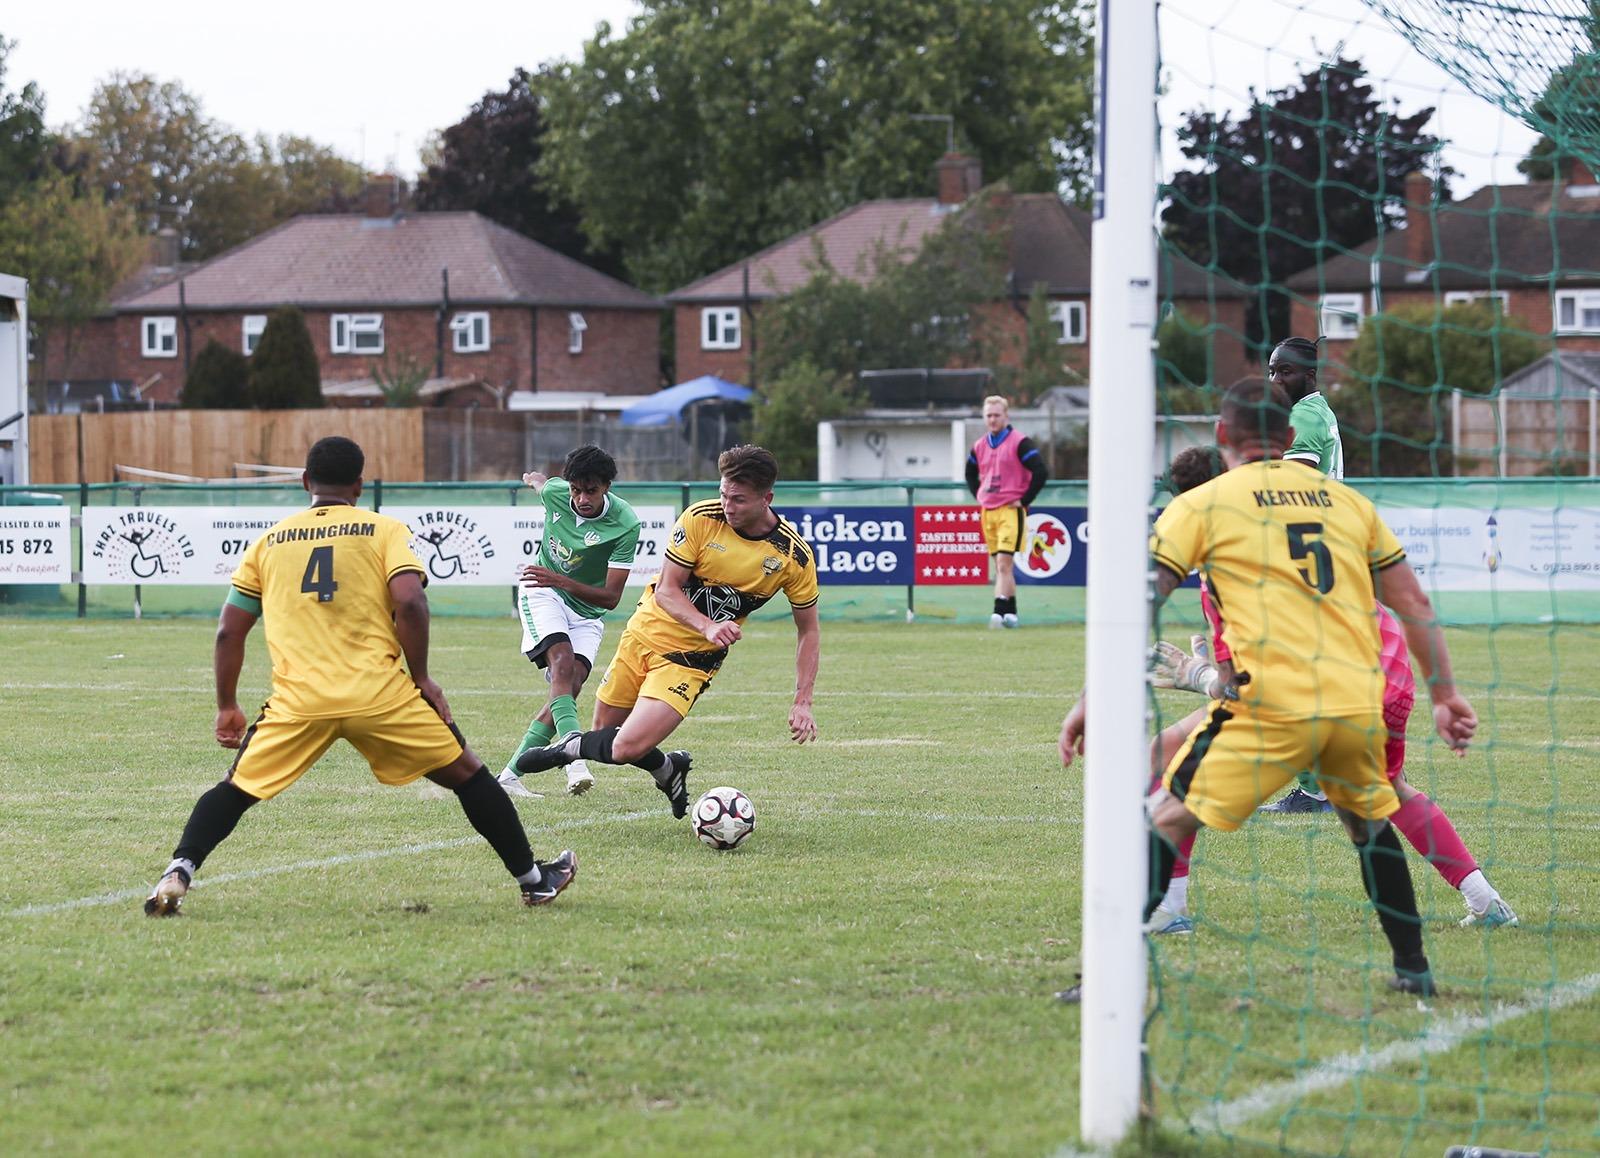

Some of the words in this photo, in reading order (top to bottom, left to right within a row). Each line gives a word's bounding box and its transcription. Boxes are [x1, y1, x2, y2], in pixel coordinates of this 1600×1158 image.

[1253, 489, 1333, 508] KEATING
[514, 521, 545, 529] INFO@
[640, 521, 666, 529] O.UK
[1409, 524, 1472, 537] business
[93, 525, 116, 558] SHAZ
[119, 511, 177, 533] TRAVELS
[177, 534, 195, 558] LTD
[266, 523, 376, 548] CUNNINGHAM
[418, 511, 478, 533] TRAVELS
[478, 534, 495, 559] LTD
[920, 532, 956, 543] TASTE
[956, 532, 980, 543] THE
[0, 539, 15, 555] 15
[23, 539, 54, 555] 872
[522, 540, 543, 555] 07
[636, 540, 657, 556] 72
[916, 543, 988, 554] DIFFERENCE
[816, 544, 898, 573] lace
[1286, 522, 1335, 595] 5
[301, 545, 338, 603] 4
